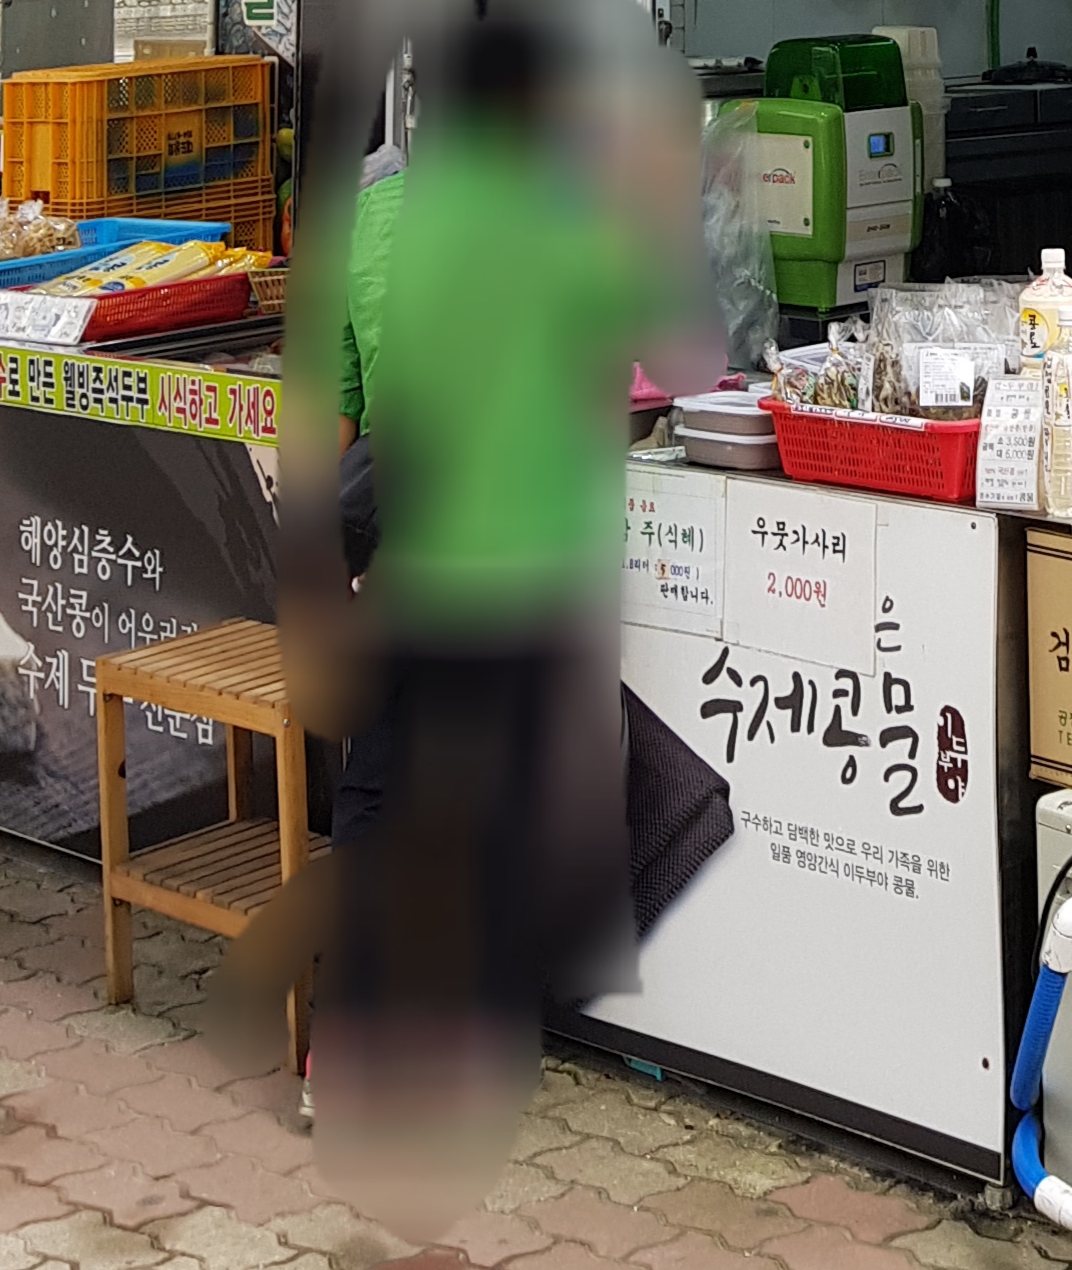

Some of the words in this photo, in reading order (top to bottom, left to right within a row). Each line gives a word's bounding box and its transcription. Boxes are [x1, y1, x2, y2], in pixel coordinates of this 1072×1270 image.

[28, 356, 56, 406] 만든
[63, 359, 150, 423] 웰빙즉석두부
[158, 371, 220, 429] 시식하고
[228, 381, 278, 438] 가세요
[19, 515, 164, 591] 해양심층수와
[751, 517, 847, 563] 우뭇가사리
[18, 577, 109, 644] 국산콩이
[767, 571, 828, 608] 2,000원
[18, 641, 69, 710] 수제
[740, 811, 784, 836] 구수하고
[787, 822, 820, 848] 담백한
[823, 832, 858, 856] 맛으로
[861, 842, 884, 864] 우리
[888, 849, 922, 874] 가족을
[927, 859, 951, 882] 위한
[770, 842, 793, 865] 일품
[795, 849, 840, 879] 영양간식
[843, 862, 889, 892] 이두부야
[892, 875, 920, 900] 콩물.
